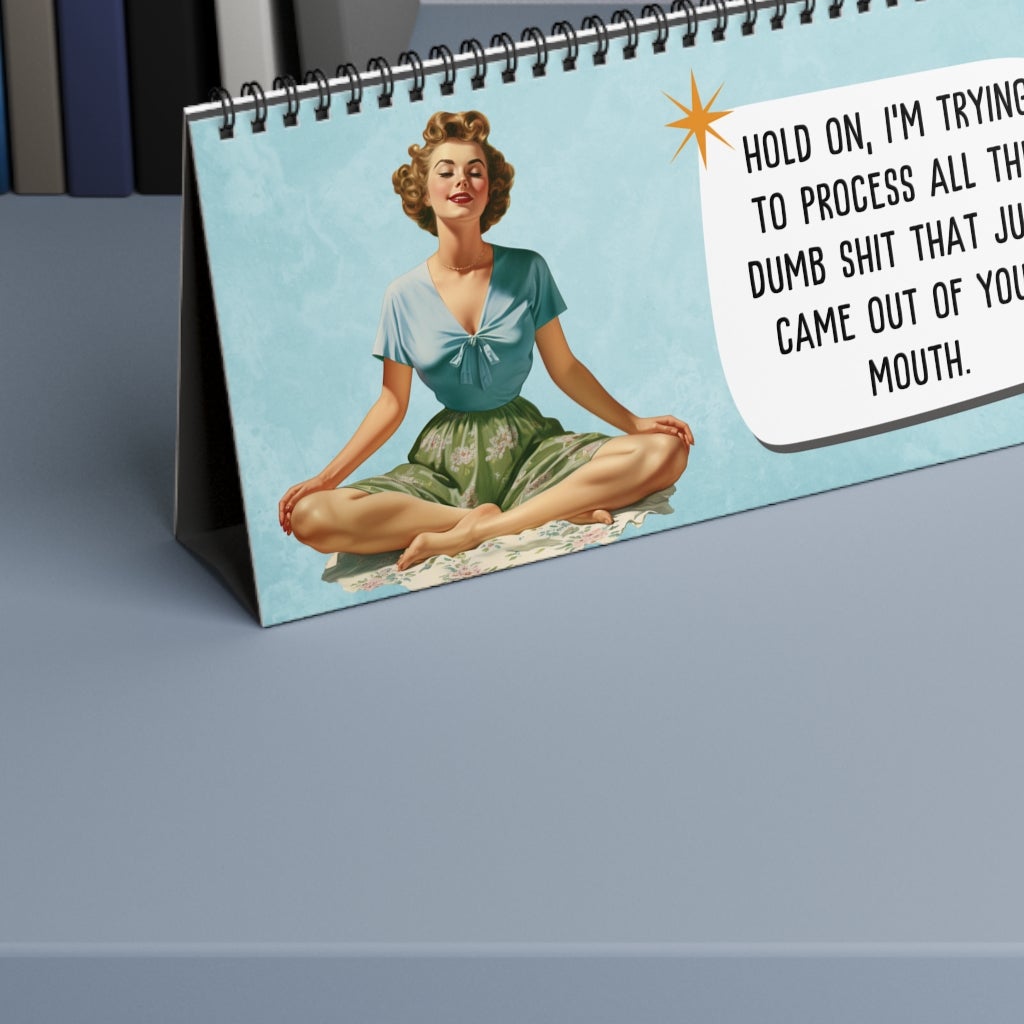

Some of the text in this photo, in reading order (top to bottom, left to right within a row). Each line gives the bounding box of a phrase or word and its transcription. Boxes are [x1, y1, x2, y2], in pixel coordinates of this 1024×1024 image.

[742, 124, 812, 174] HOLD
[825, 111, 873, 155] ON,
[884, 100, 925, 144] I'M
[751, 192, 787, 234] TO
[800, 164, 916, 225] PROCESS
[930, 152, 977, 197] ALL
[747, 246, 826, 299] DUMB
[839, 230, 895, 278] SHIT
[909, 212, 978, 262] THAT
[776, 303, 856, 355] CAME
[867, 287, 917, 334] OUT
[932, 277, 962, 319] OF
[868, 339, 972, 397] MOUTH.
